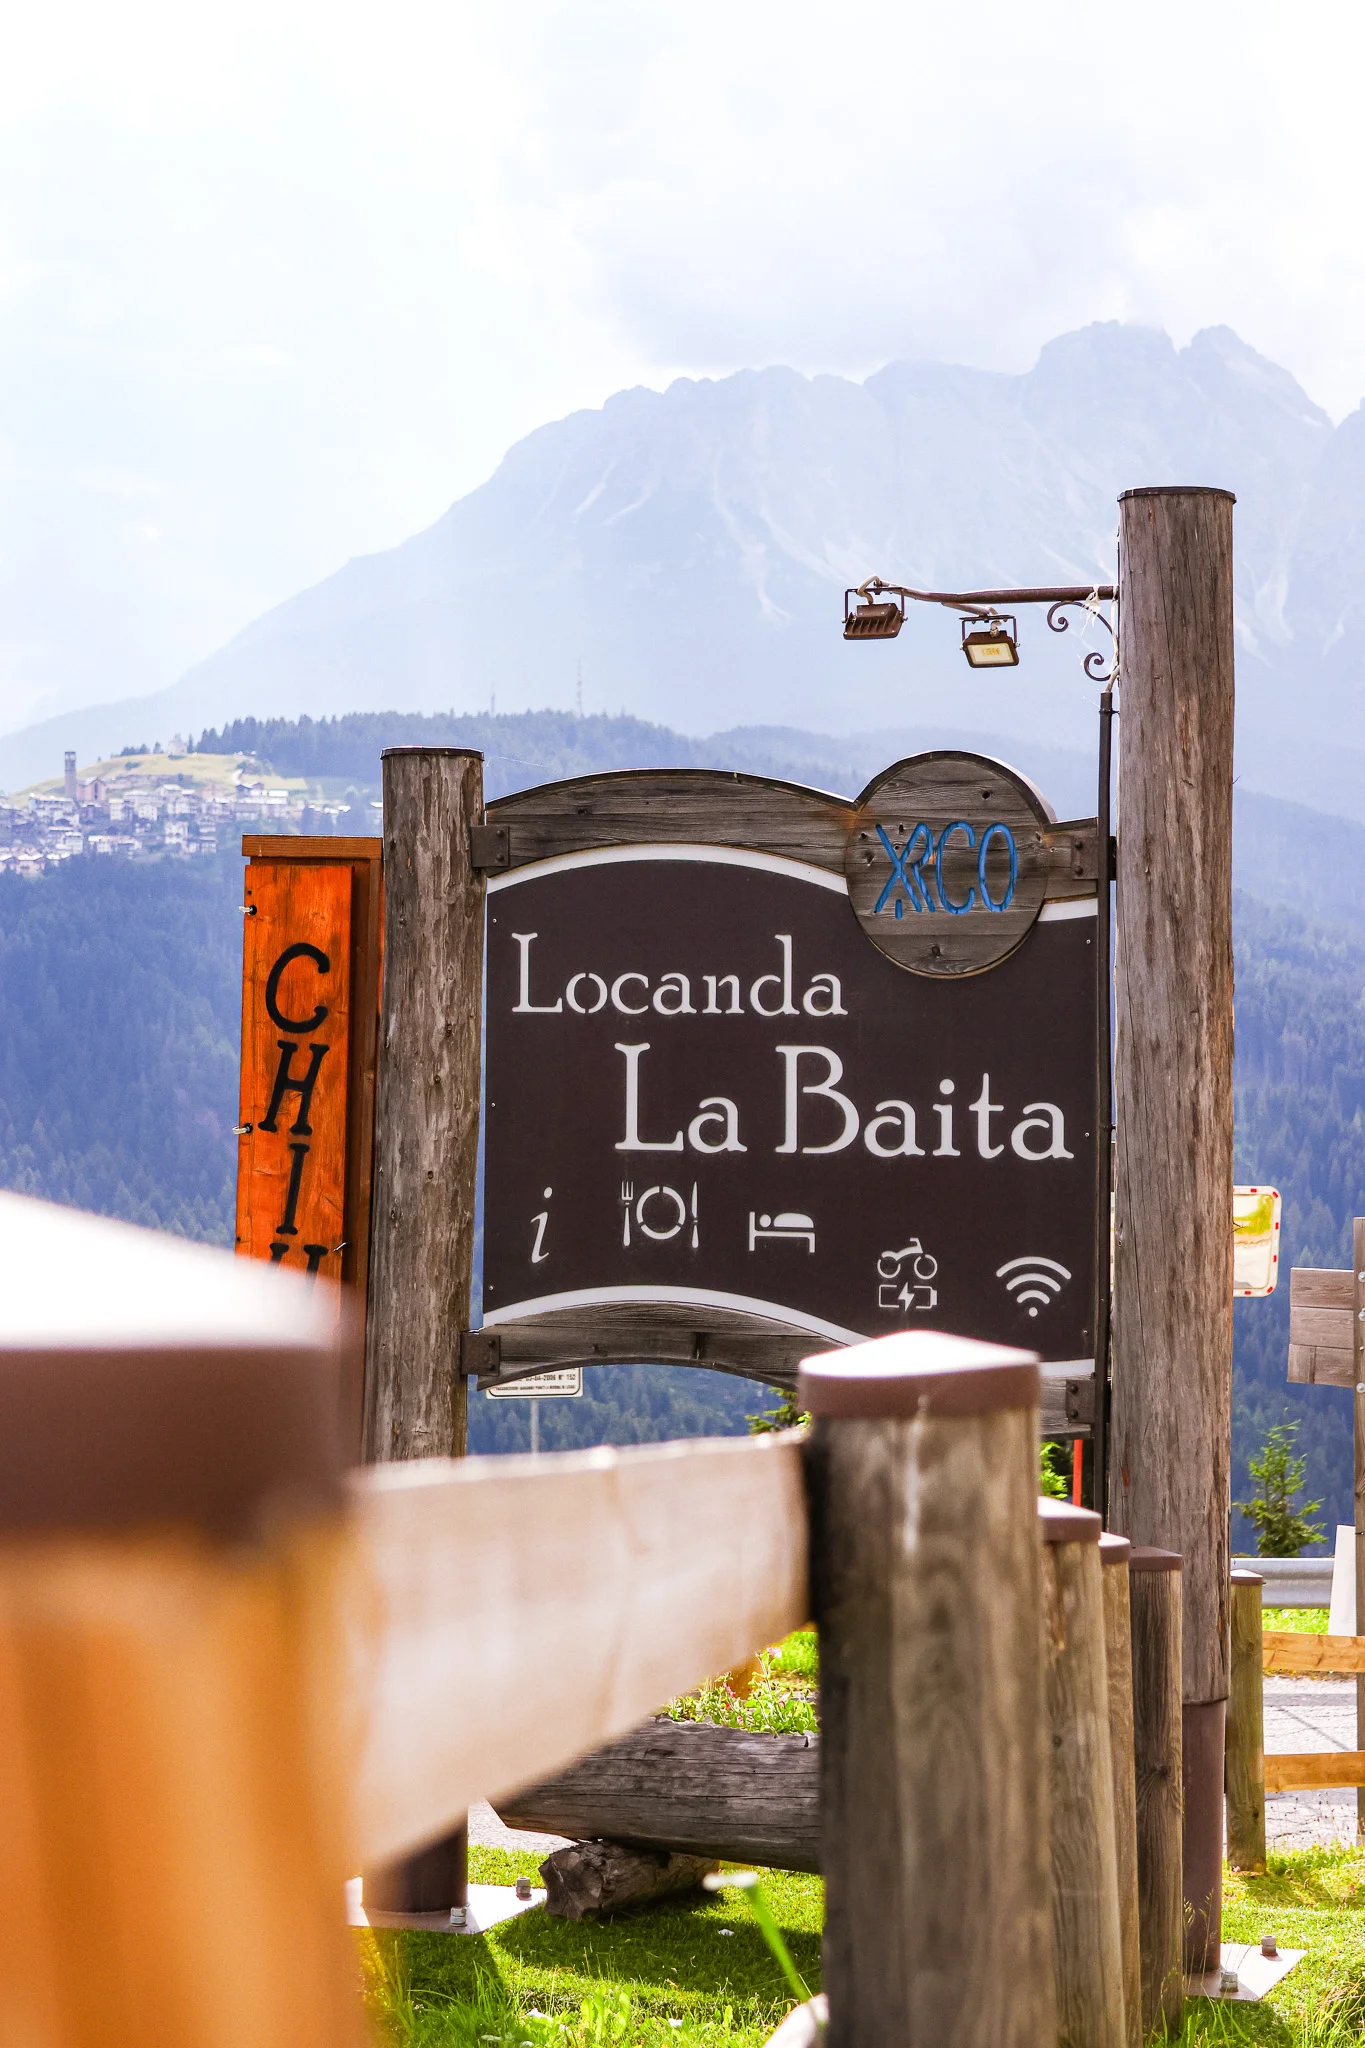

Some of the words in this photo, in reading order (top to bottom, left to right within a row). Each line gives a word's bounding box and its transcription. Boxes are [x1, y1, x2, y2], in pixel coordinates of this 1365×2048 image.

[511, 932, 849, 1017] Locanda
[614, 1042, 748, 1154] La
[775, 1045, 1075, 1161] Baita
